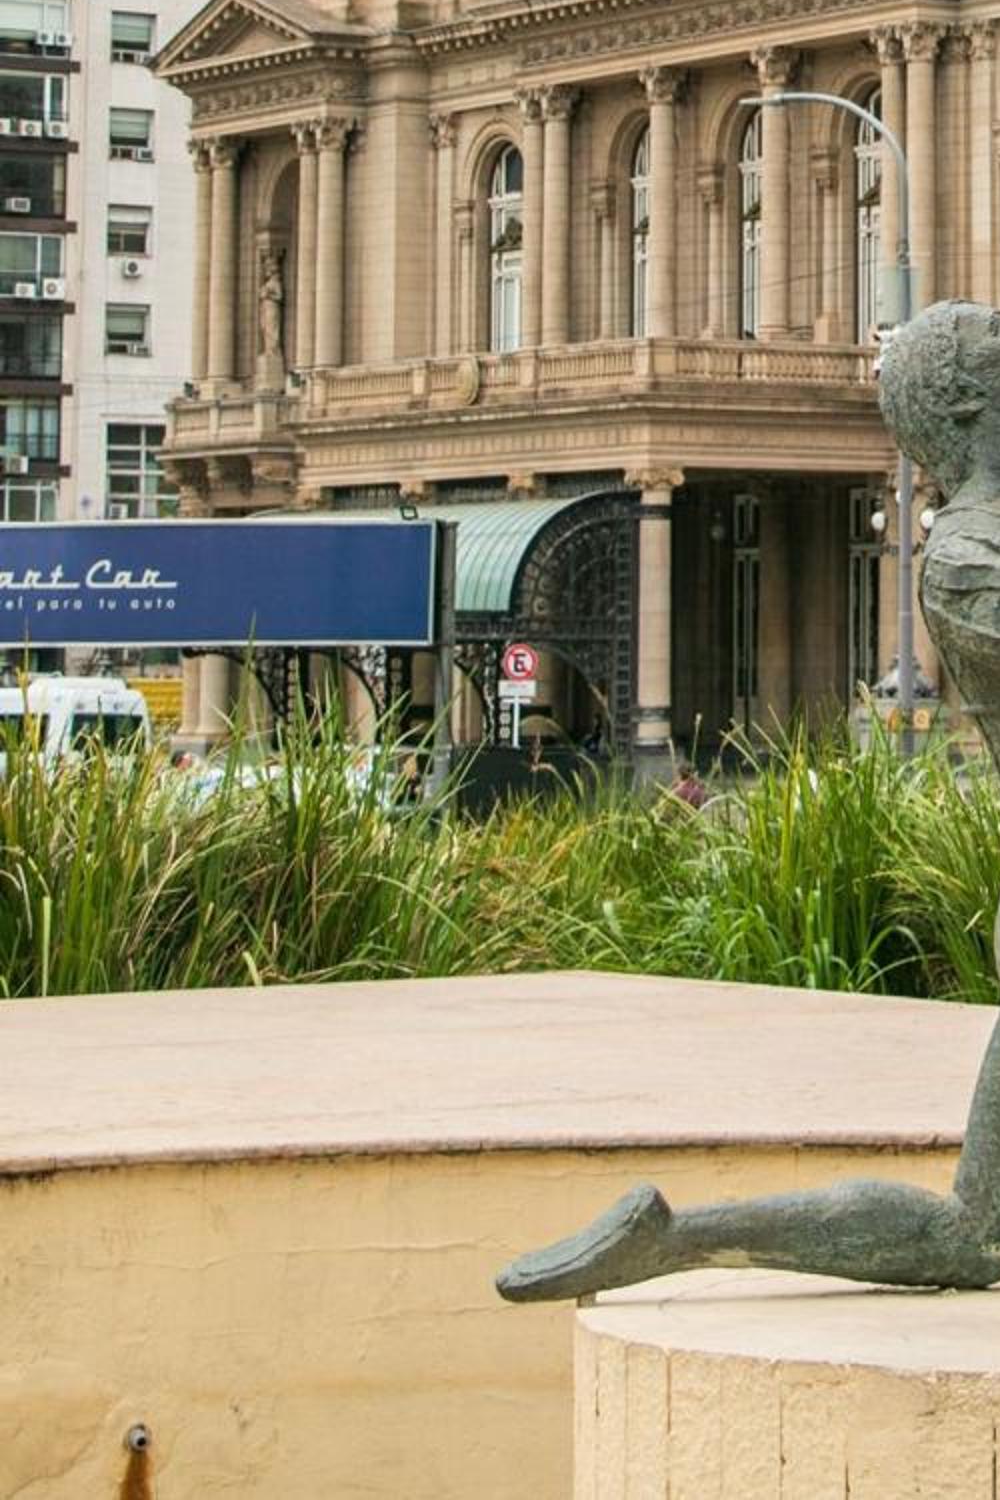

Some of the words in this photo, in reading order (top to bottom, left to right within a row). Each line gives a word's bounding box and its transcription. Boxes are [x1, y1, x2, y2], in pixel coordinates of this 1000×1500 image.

[85, 559, 178, 589] Car
[37, 598, 83, 612] para
[99, 597, 117, 610] tu
[130, 597, 176, 610] auto
